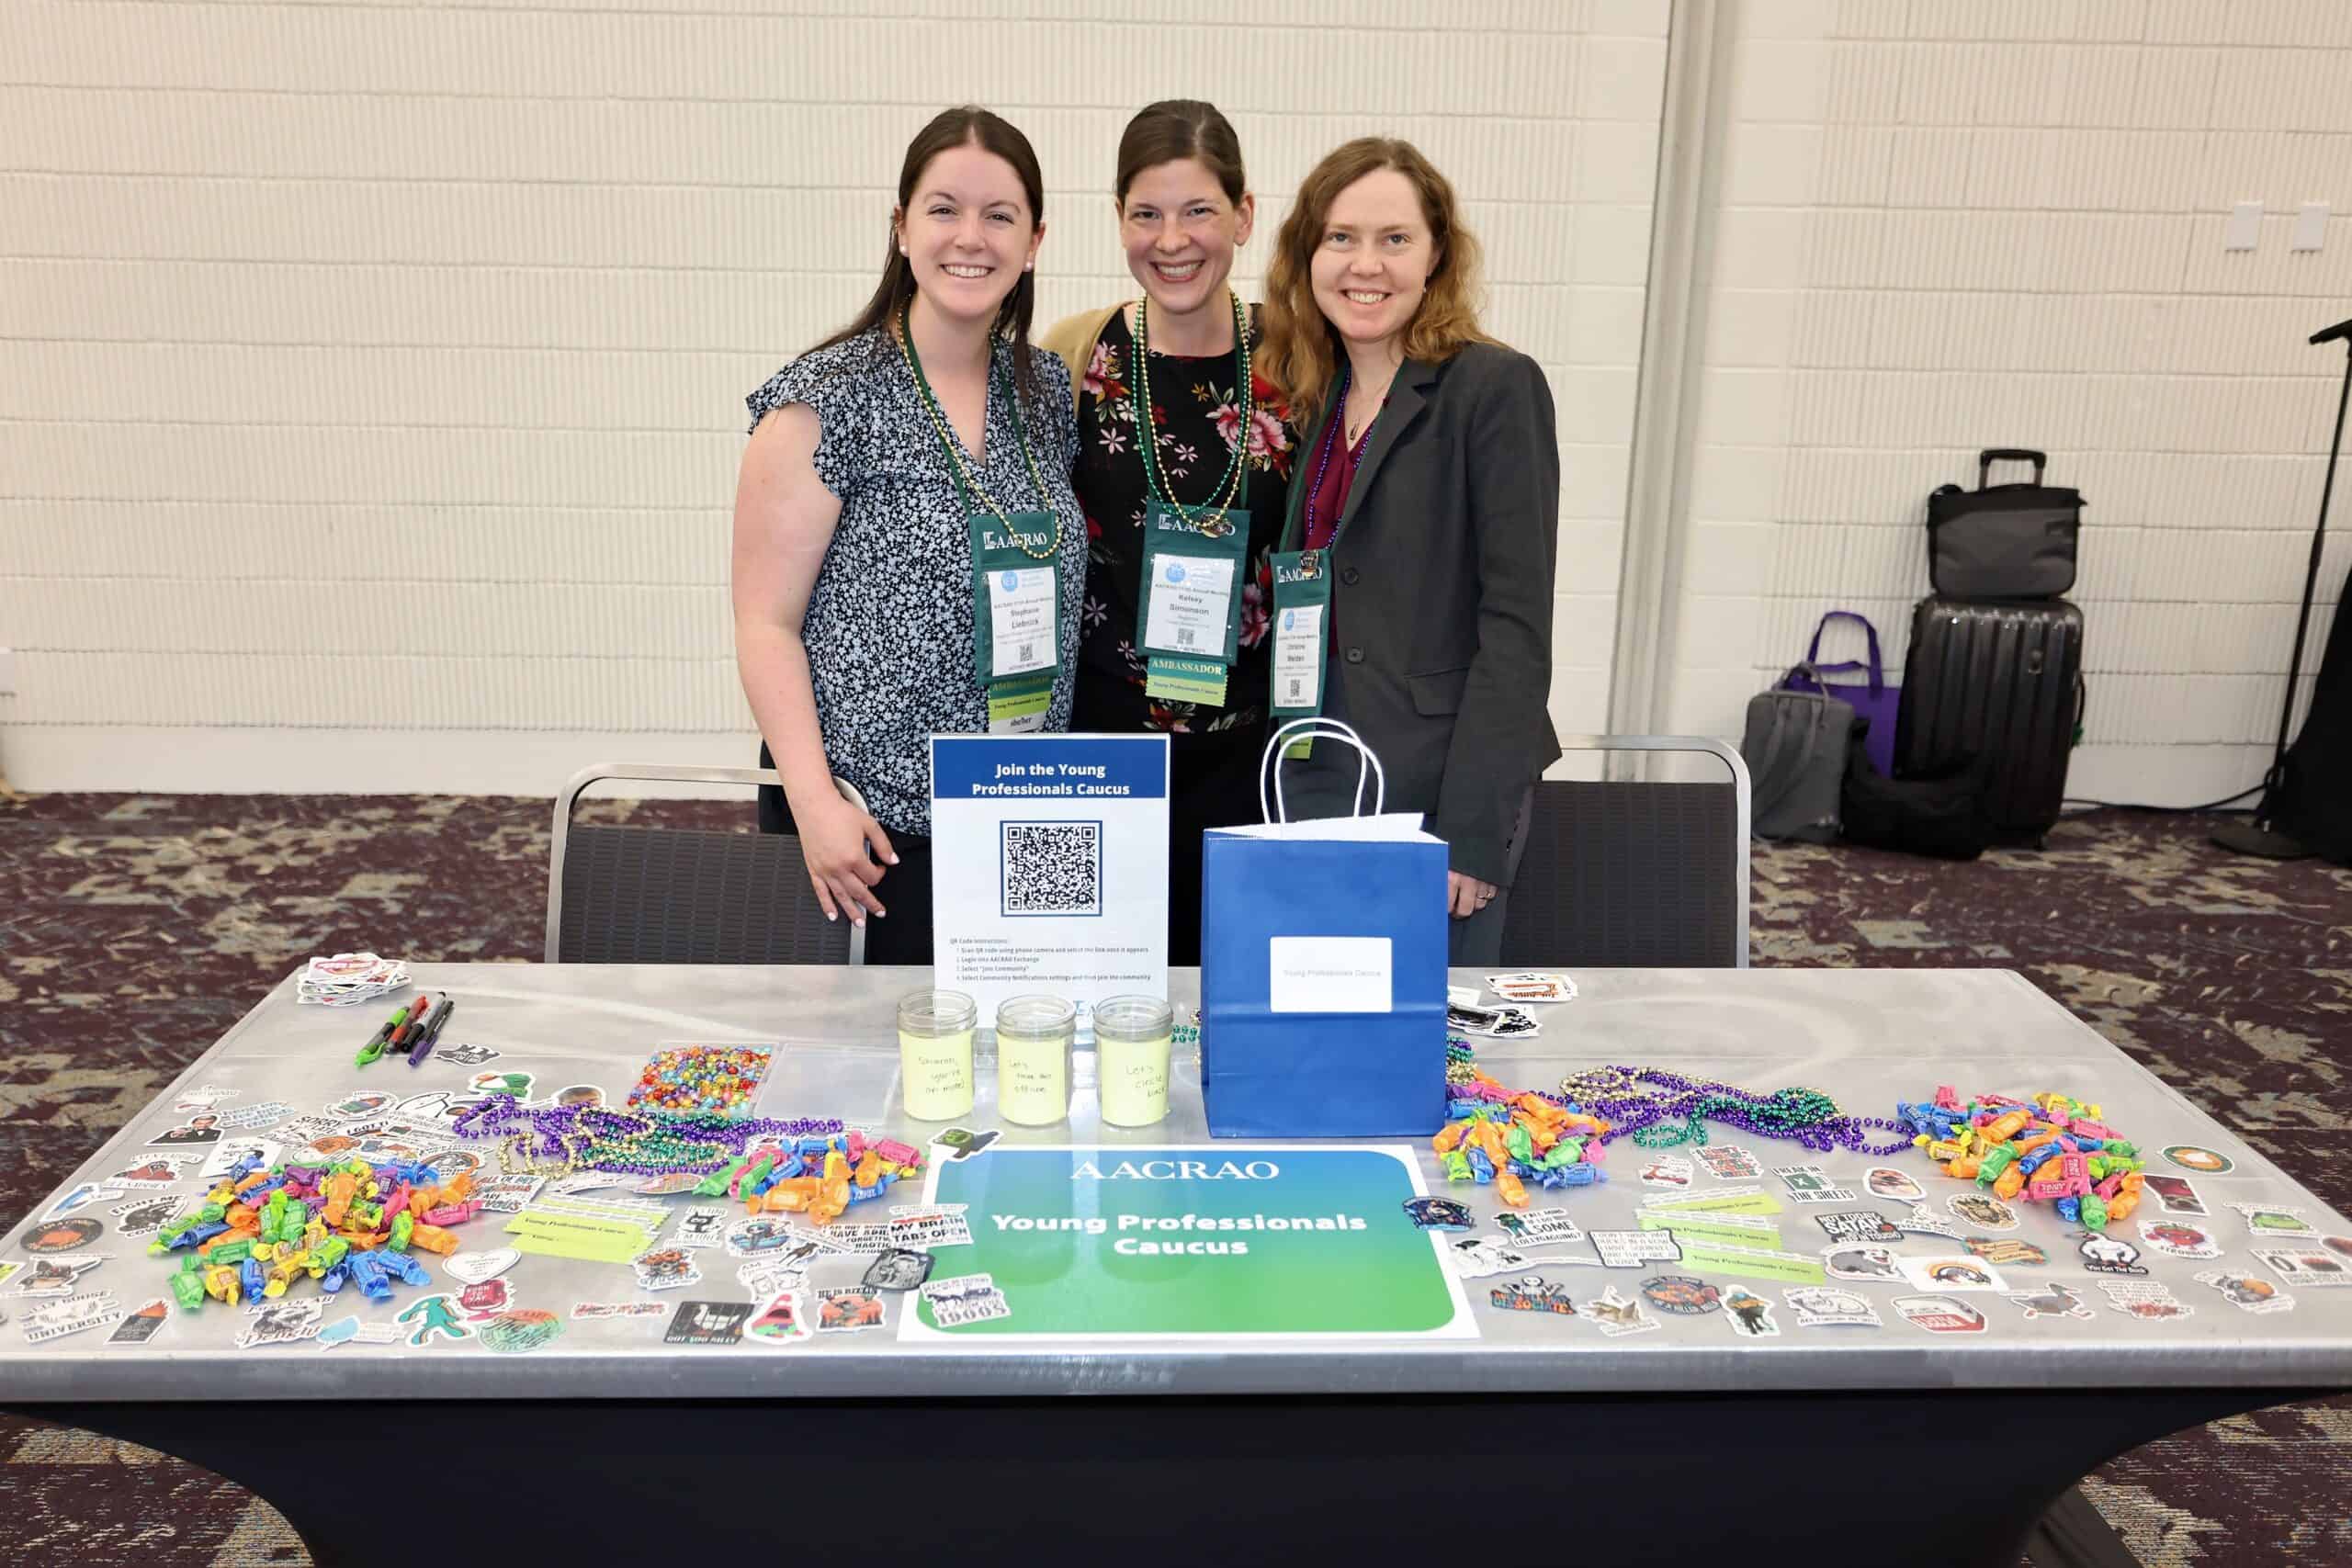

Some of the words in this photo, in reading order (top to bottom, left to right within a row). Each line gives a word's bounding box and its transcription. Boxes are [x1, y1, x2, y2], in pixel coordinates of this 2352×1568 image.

[997, 532, 1047, 549] AACRAO
[1151, 659, 1222, 676] AMBASSADOR
[994, 763, 1025, 779] Join
[1029, 763, 1054, 776] the
[1058, 763, 1105, 779] Young
[972, 783, 1073, 795] Professionals
[1077, 784, 1130, 795] Caucus
[1070, 1160, 1280, 1180] AACRAO
[1814, 1190, 1854, 1200] SHEETS
[891, 1223, 914, 1233] MY
[919, 1217, 965, 1229] BRAIN
[992, 1214, 1108, 1235] Young
[1118, 1213, 1367, 1231] Professionals
[1532, 1221, 1577, 1234] SOME
[1824, 1218, 1883, 1234] SATAN
[893, 1232, 927, 1243] TABS
[931, 1227, 969, 1238] OPEN
[1114, 1237, 1250, 1255] Caucus
[1693, 1255, 1720, 1264] Young
[1722, 1258, 1778, 1269] Professionals
[1779, 1264, 1812, 1274] Caucus
[28, 1310, 122, 1341] UNIVERSITY
